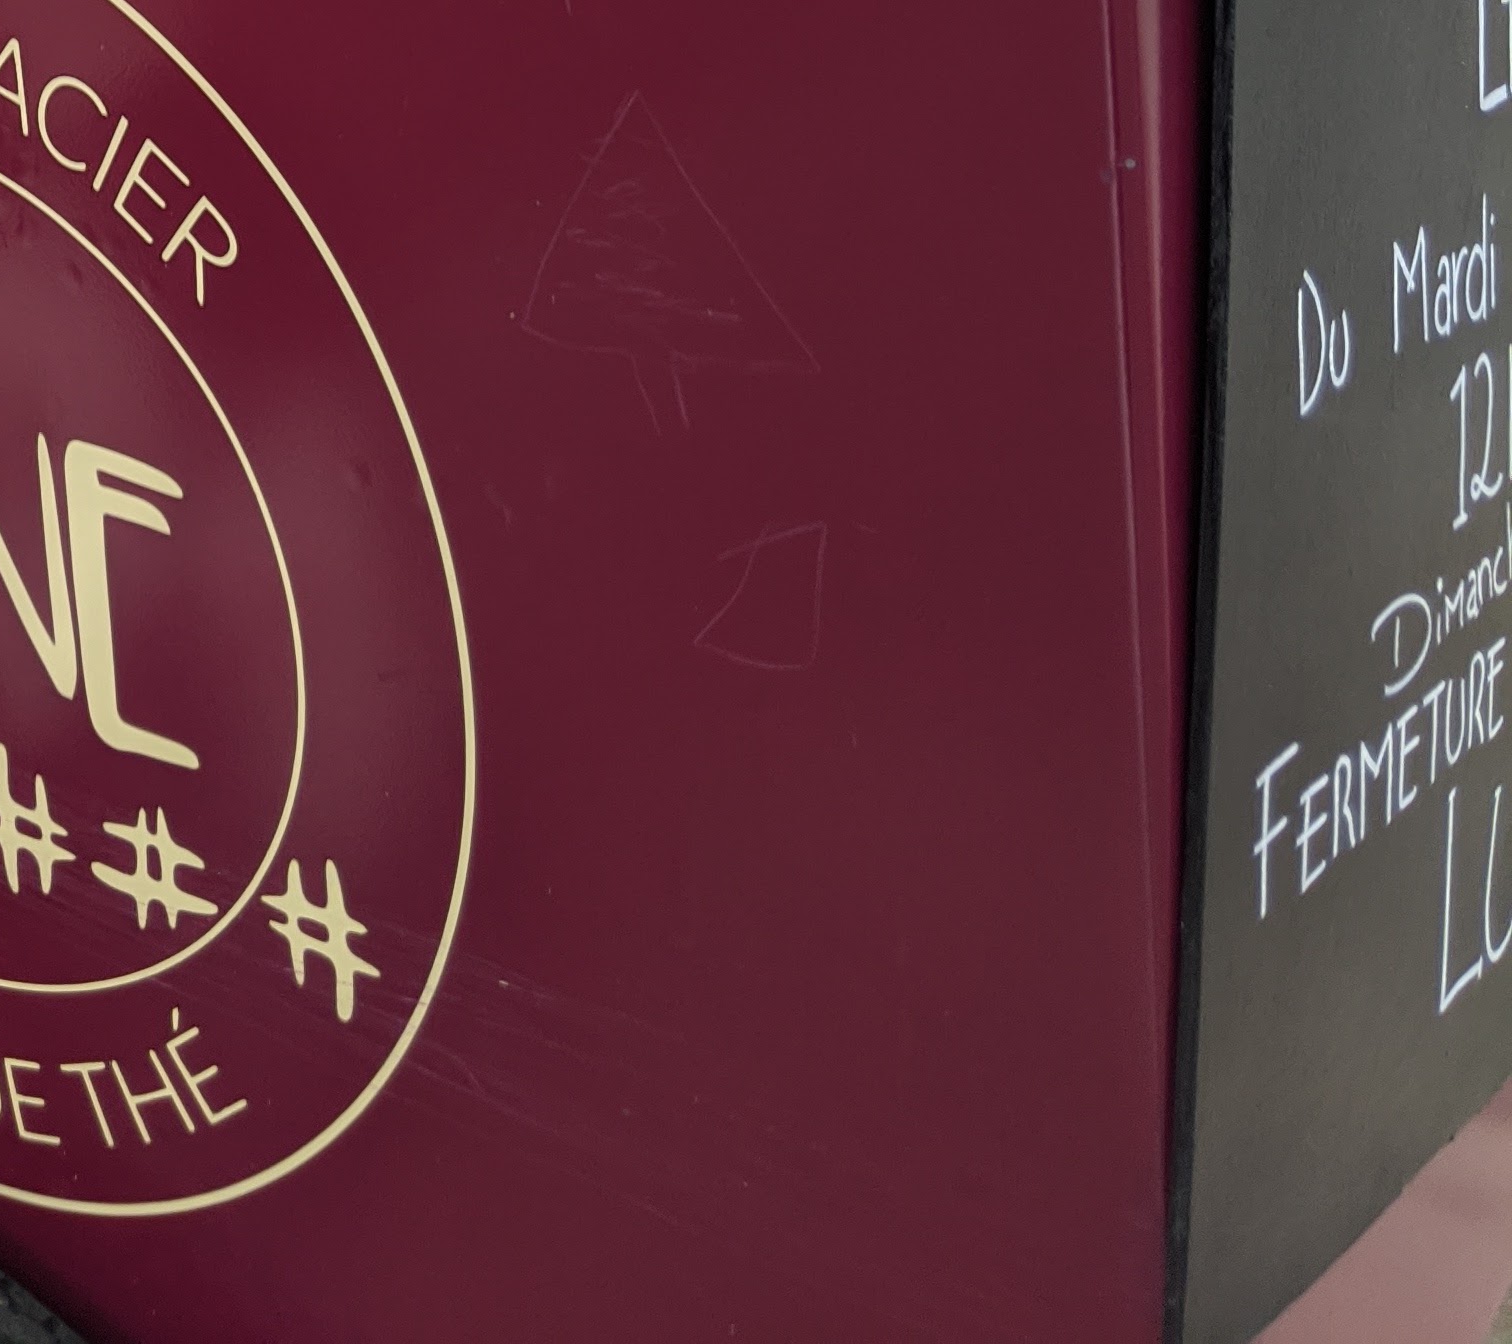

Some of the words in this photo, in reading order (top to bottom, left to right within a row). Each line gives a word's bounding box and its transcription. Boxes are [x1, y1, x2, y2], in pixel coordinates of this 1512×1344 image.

[1392, 193, 1496, 354] Mardi
[1253, 637, 1507, 920] FERMETURE
[62, 1006, 249, 1148] THÉ
